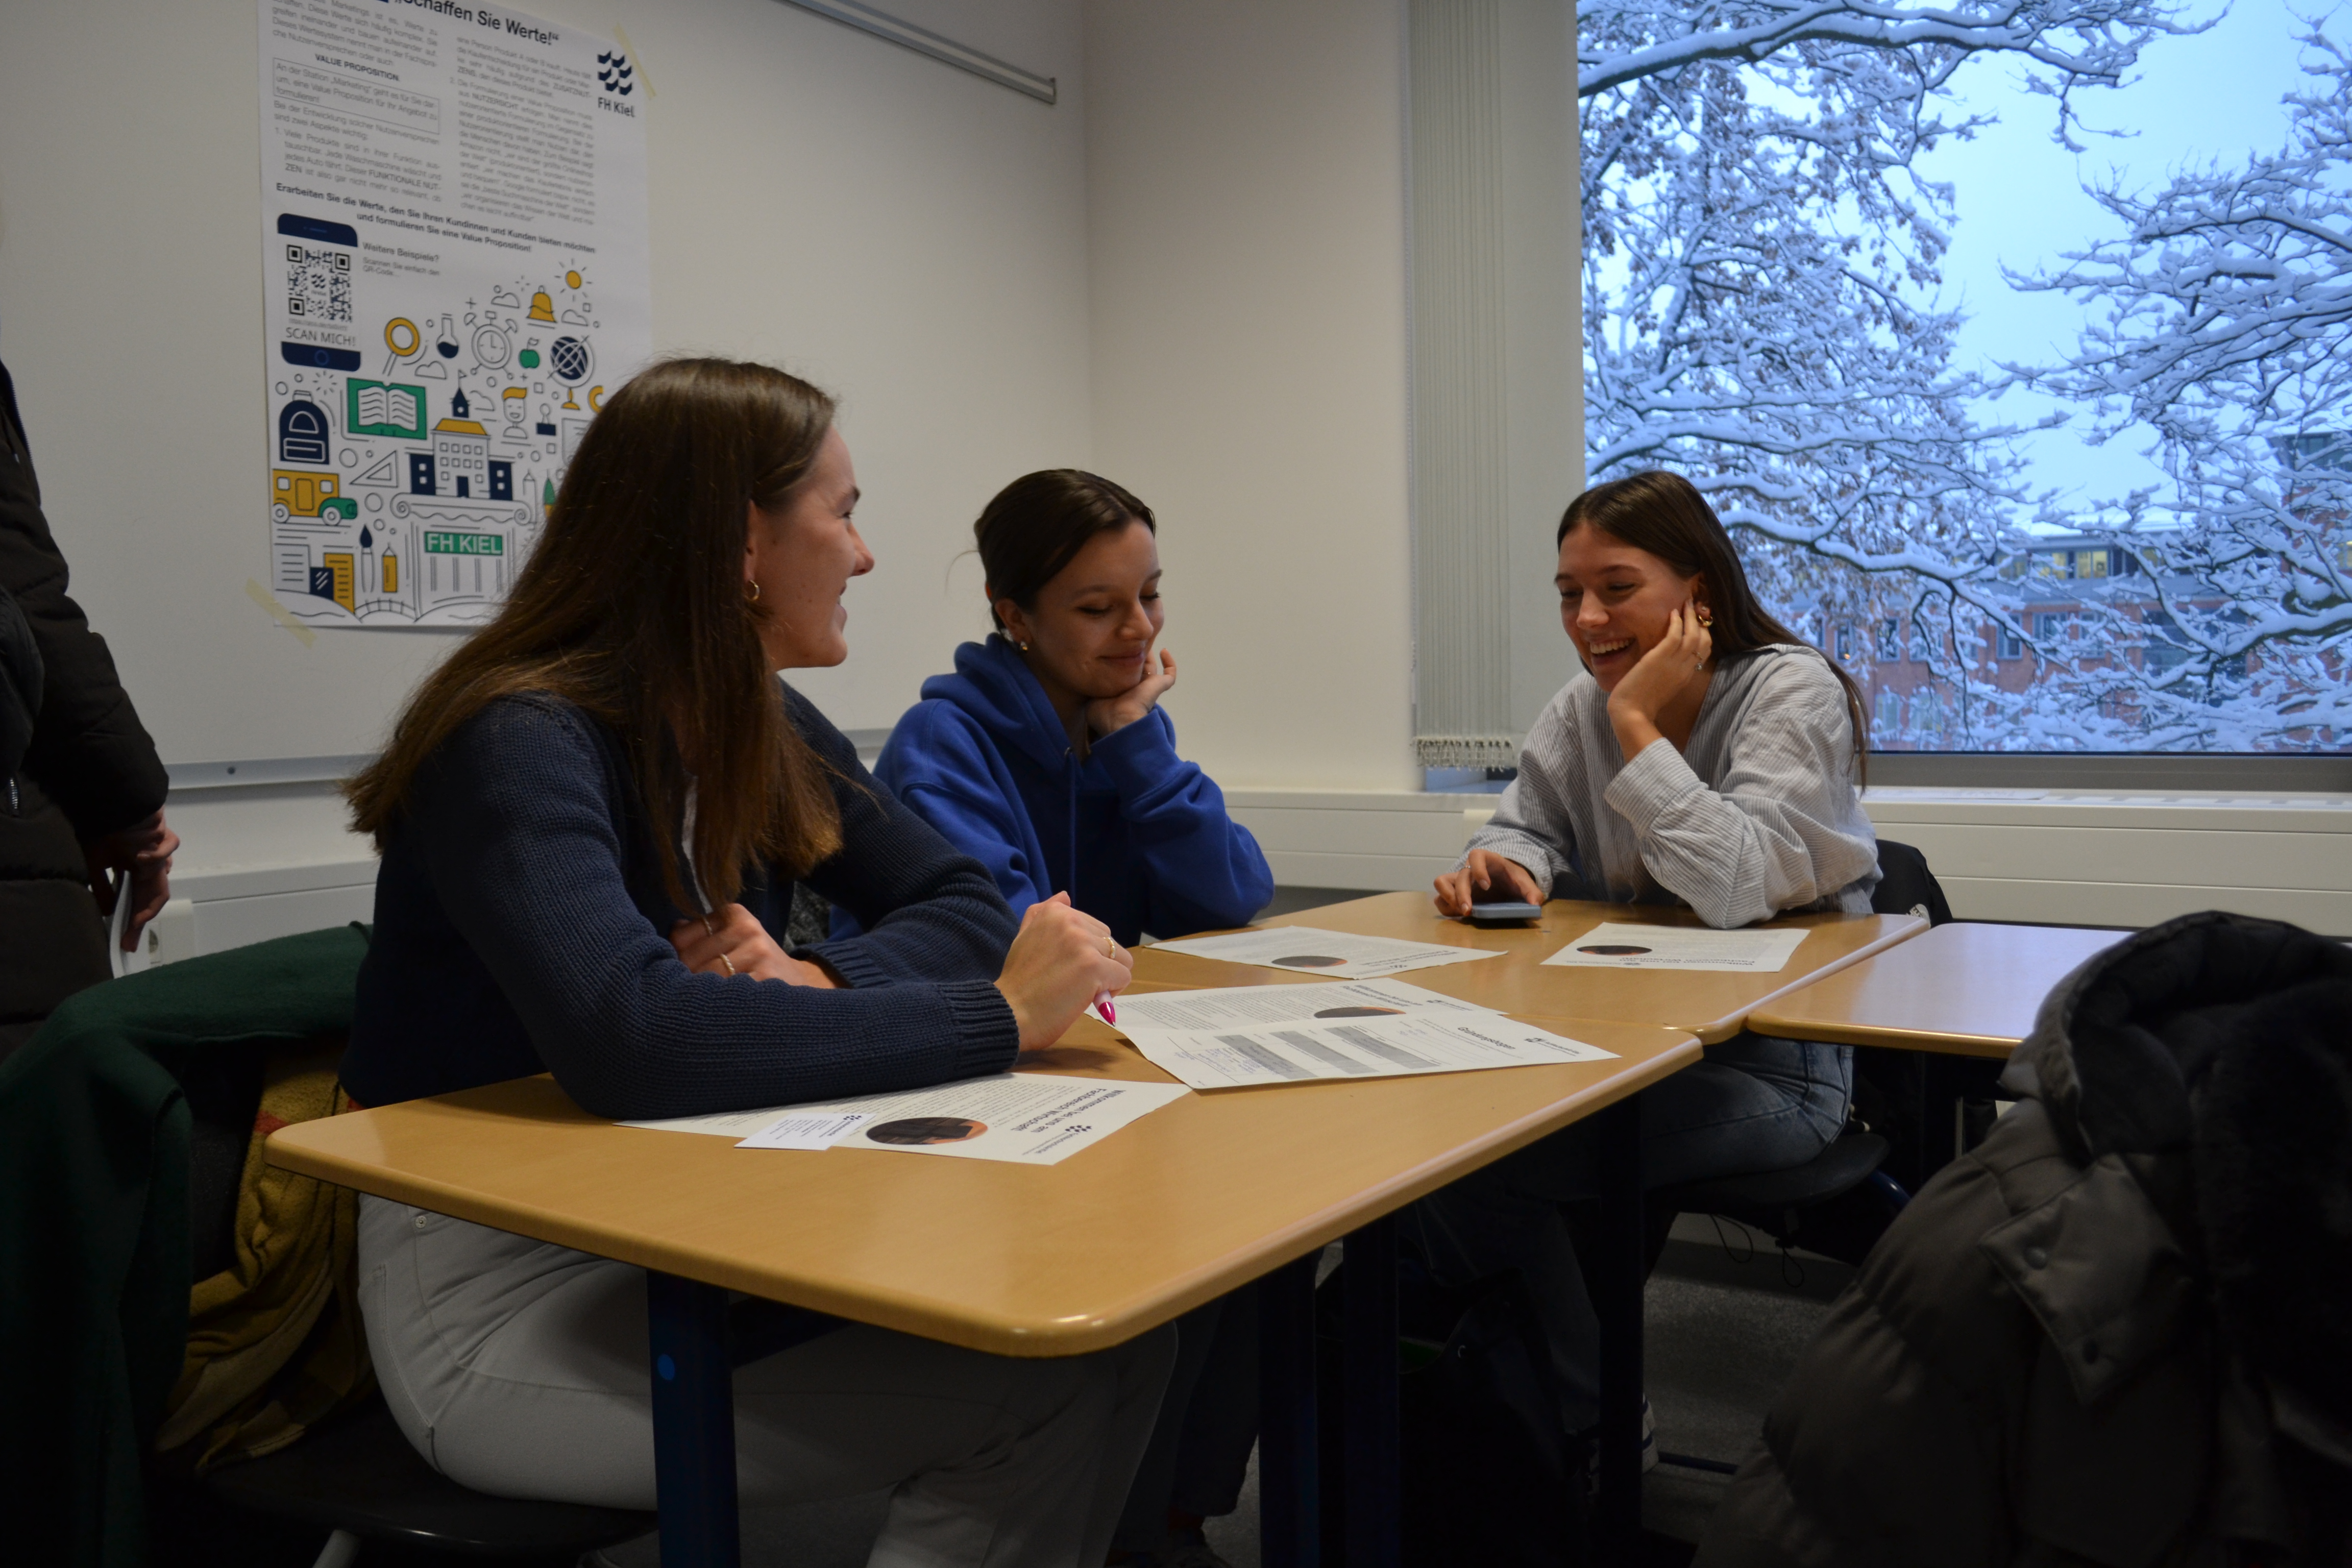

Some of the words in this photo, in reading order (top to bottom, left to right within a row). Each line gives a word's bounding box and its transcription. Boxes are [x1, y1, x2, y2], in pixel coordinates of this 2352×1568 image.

[477, 11, 501, 30] Sie
[506, 18, 559, 45] Werte!“
[315, 54, 341, 66] VALUE
[598, 97, 611, 111] FH
[614, 102, 635, 117] Kiel
[276, 182, 324, 199] Erarbeiten
[326, 192, 340, 203] Sie
[342, 197, 356, 206] die
[358, 199, 387, 213] Werte,
[388, 206, 405, 215] den
[407, 208, 421, 218] Sie
[421, 212, 444, 223] Ihren
[446, 217, 488, 231] Kundinnen
[507, 230, 536, 241] Kunden
[538, 236, 561, 247] bieten
[564, 242, 595, 253] möchten
[356, 213, 374, 222] und
[375, 215, 425, 231] formulieren
[426, 225, 440, 234] Sie
[442, 230, 459, 238] eine
[460, 232, 483, 243] Value
[484, 236, 531, 252] Proposition!
[362, 242, 395, 255] Weitere
[397, 248, 439, 262] Beispiele?
[286, 327, 317, 341] SCAN
[321, 332, 355, 347] MICH!
[427, 533, 454, 552] FH
[460, 535, 501, 554] KIEL
[1457, 1027, 1516, 1049] Gründungsbogen
[1055, 1088, 1108, 1110] Fachbereich
[1074, 1090, 1126, 1112] Willkommen
[1045, 1117, 1065, 1125] uns
